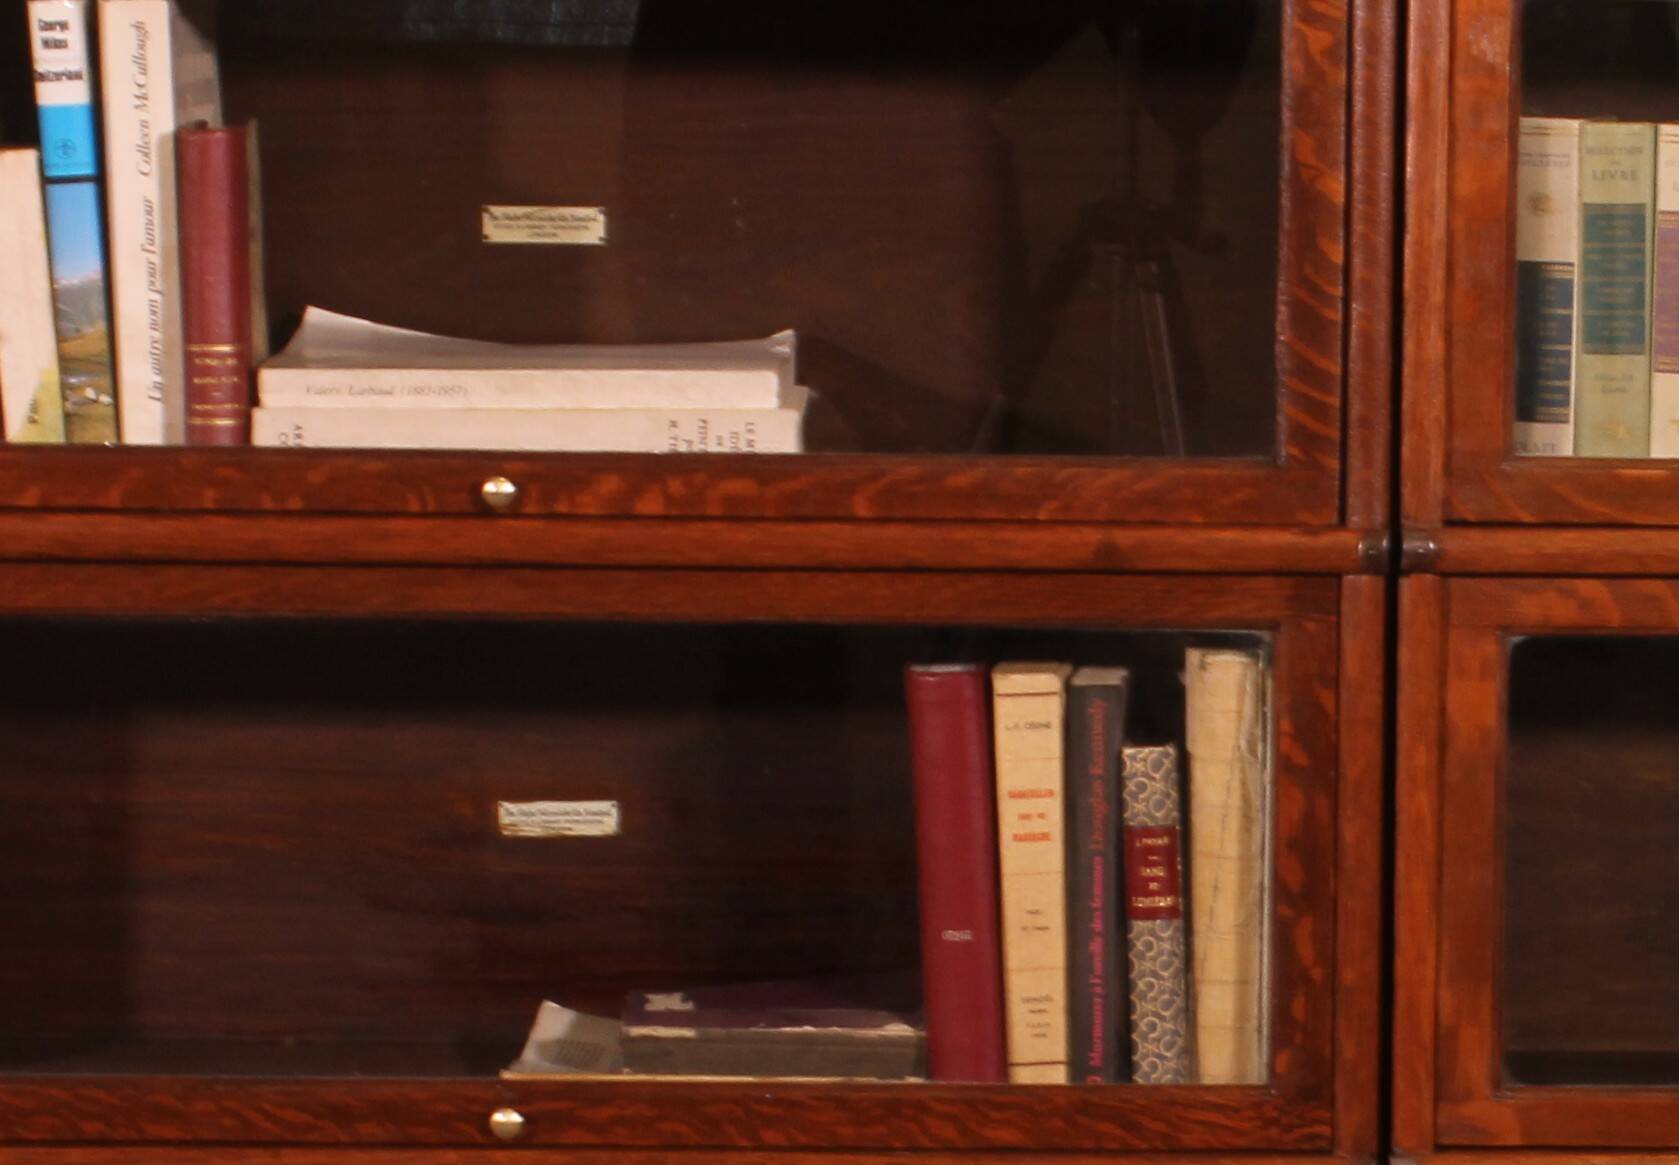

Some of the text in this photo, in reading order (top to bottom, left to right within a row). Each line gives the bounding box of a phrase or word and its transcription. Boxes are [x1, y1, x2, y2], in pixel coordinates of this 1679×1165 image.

[129, 19, 152, 113] McCullough
[135, 120, 153, 178] Colleen
[138, 196, 157, 255] l'amour
[144, 260, 163, 296] pour
[146, 299, 161, 333] nom
[146, 336, 164, 378] autre
